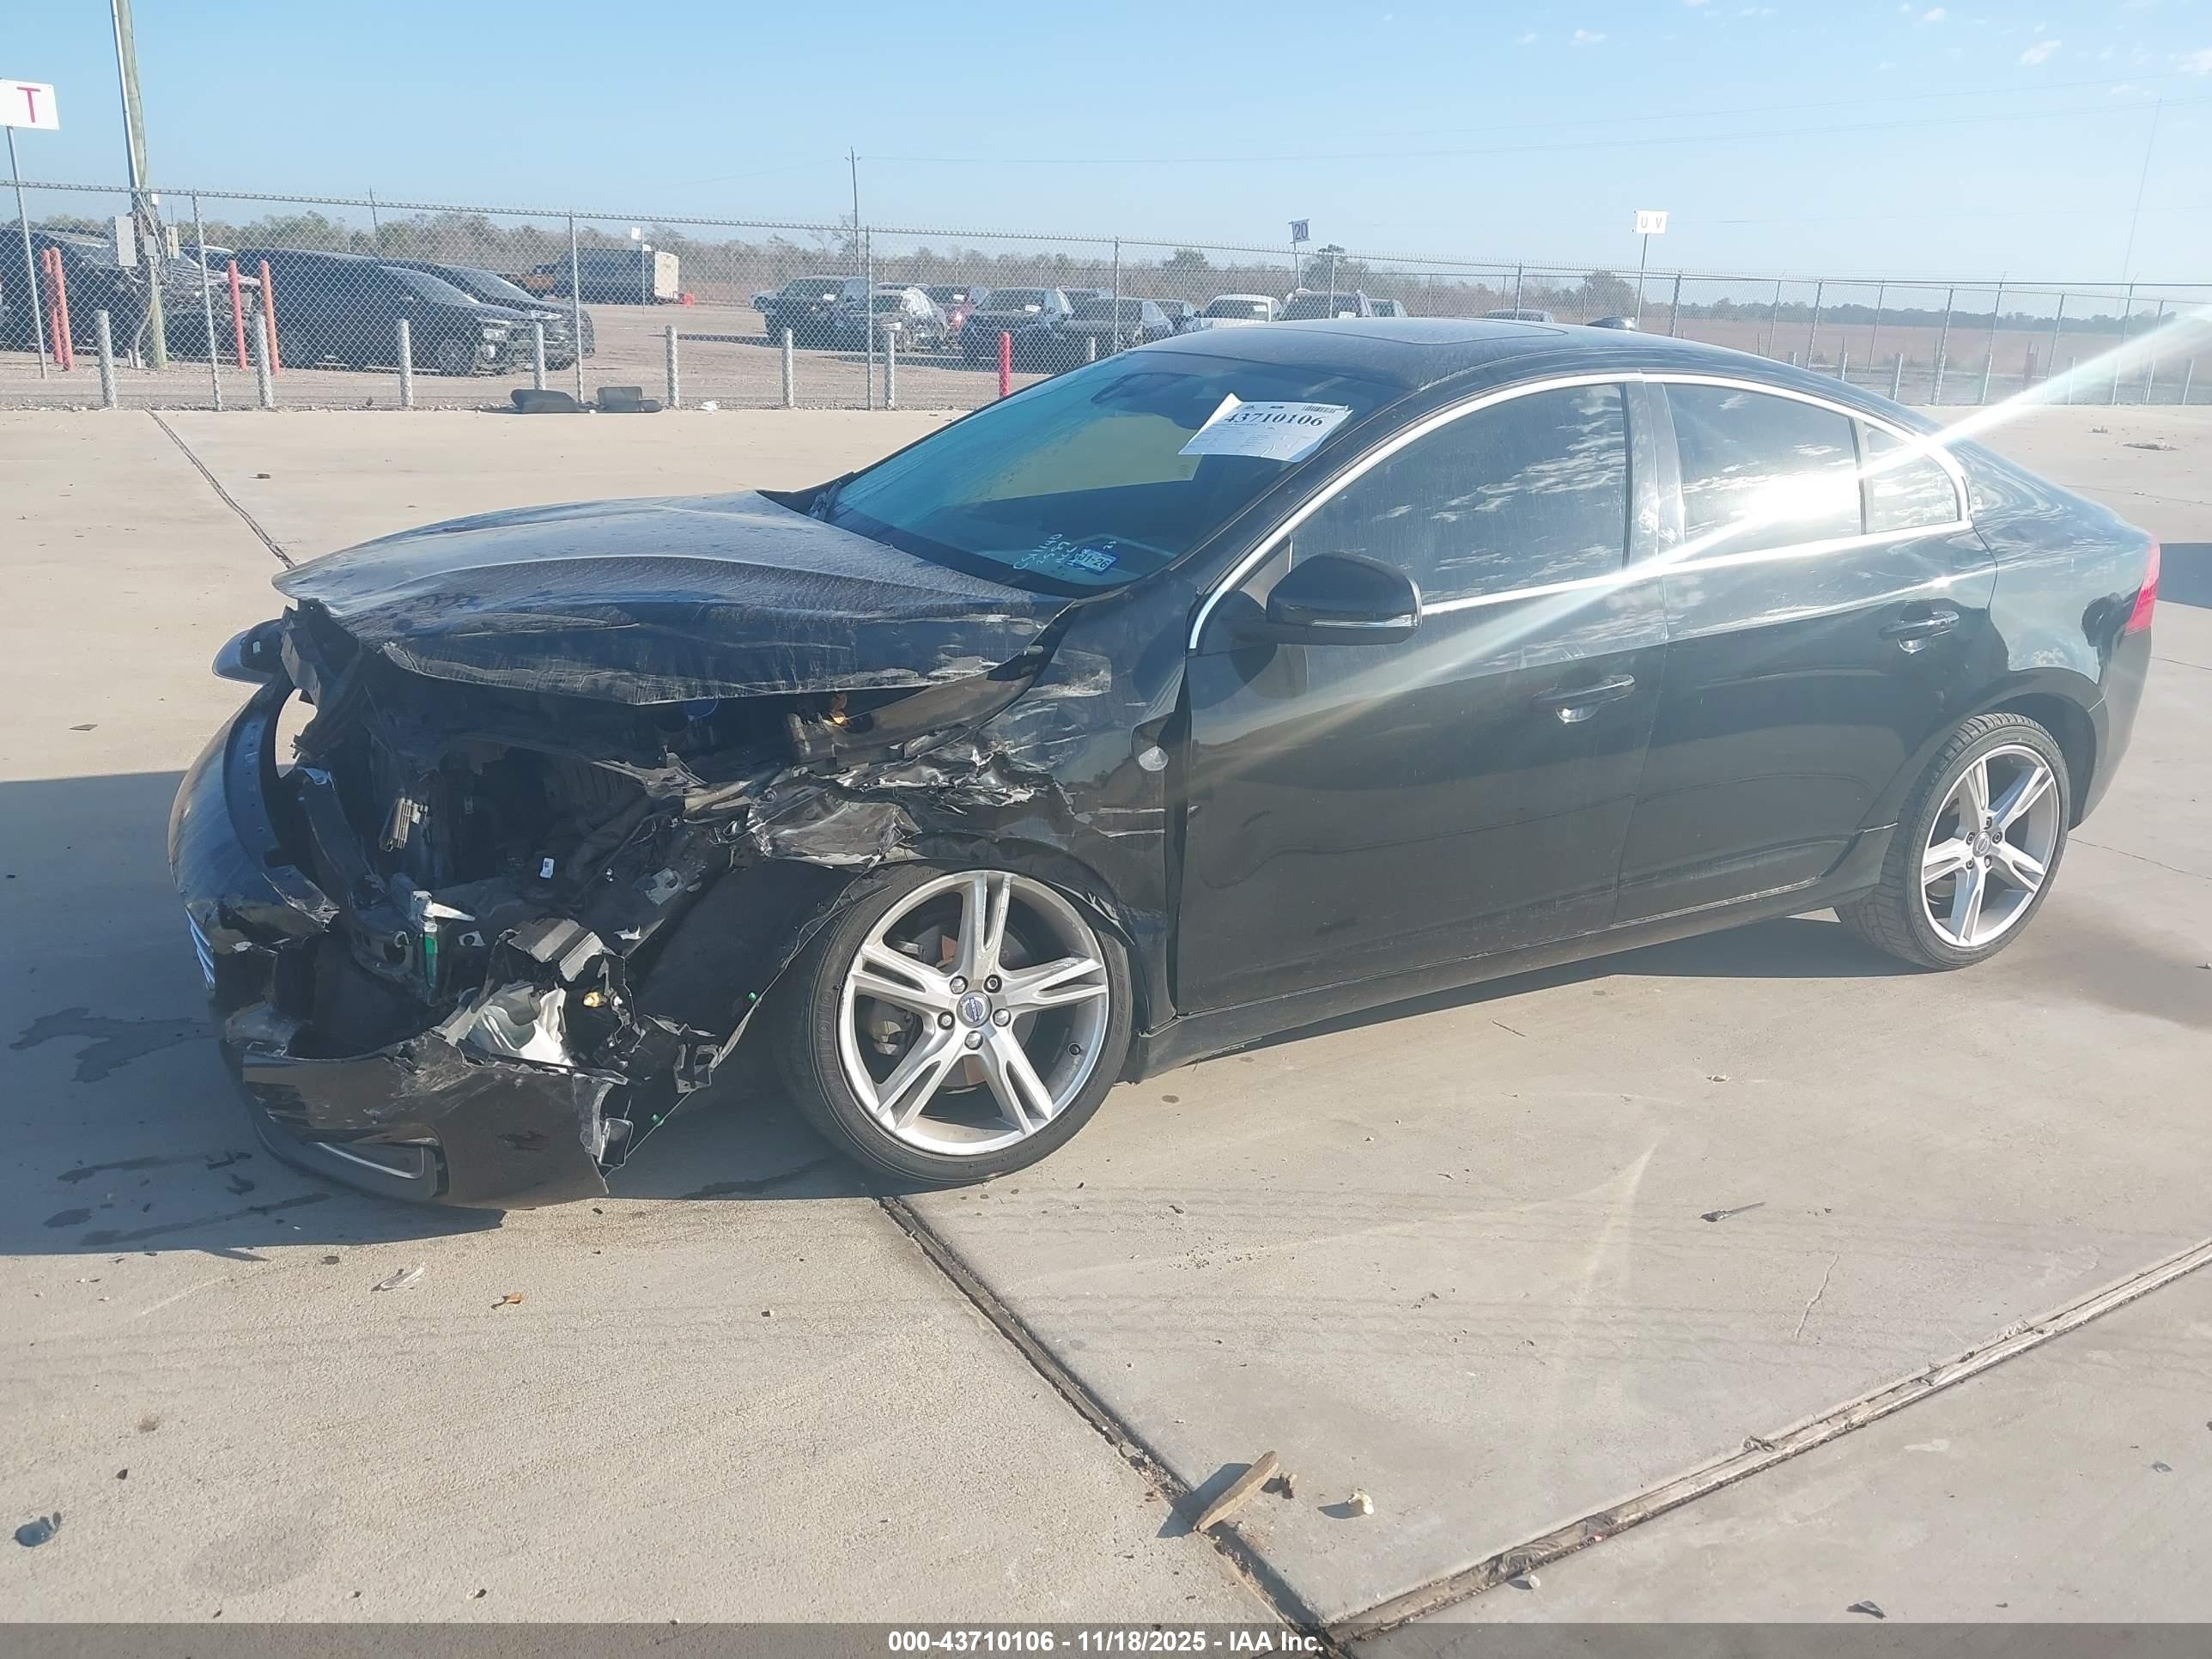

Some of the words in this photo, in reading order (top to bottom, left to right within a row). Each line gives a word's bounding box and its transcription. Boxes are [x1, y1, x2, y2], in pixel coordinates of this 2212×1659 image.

[16, 86, 41, 124] T
[1294, 222, 1308, 240] 20
[1641, 216, 1649, 228] U
[1656, 216, 1663, 228] V
[1224, 412, 1327, 427] 43710106
[969, 998, 979, 1022] VOLVO
